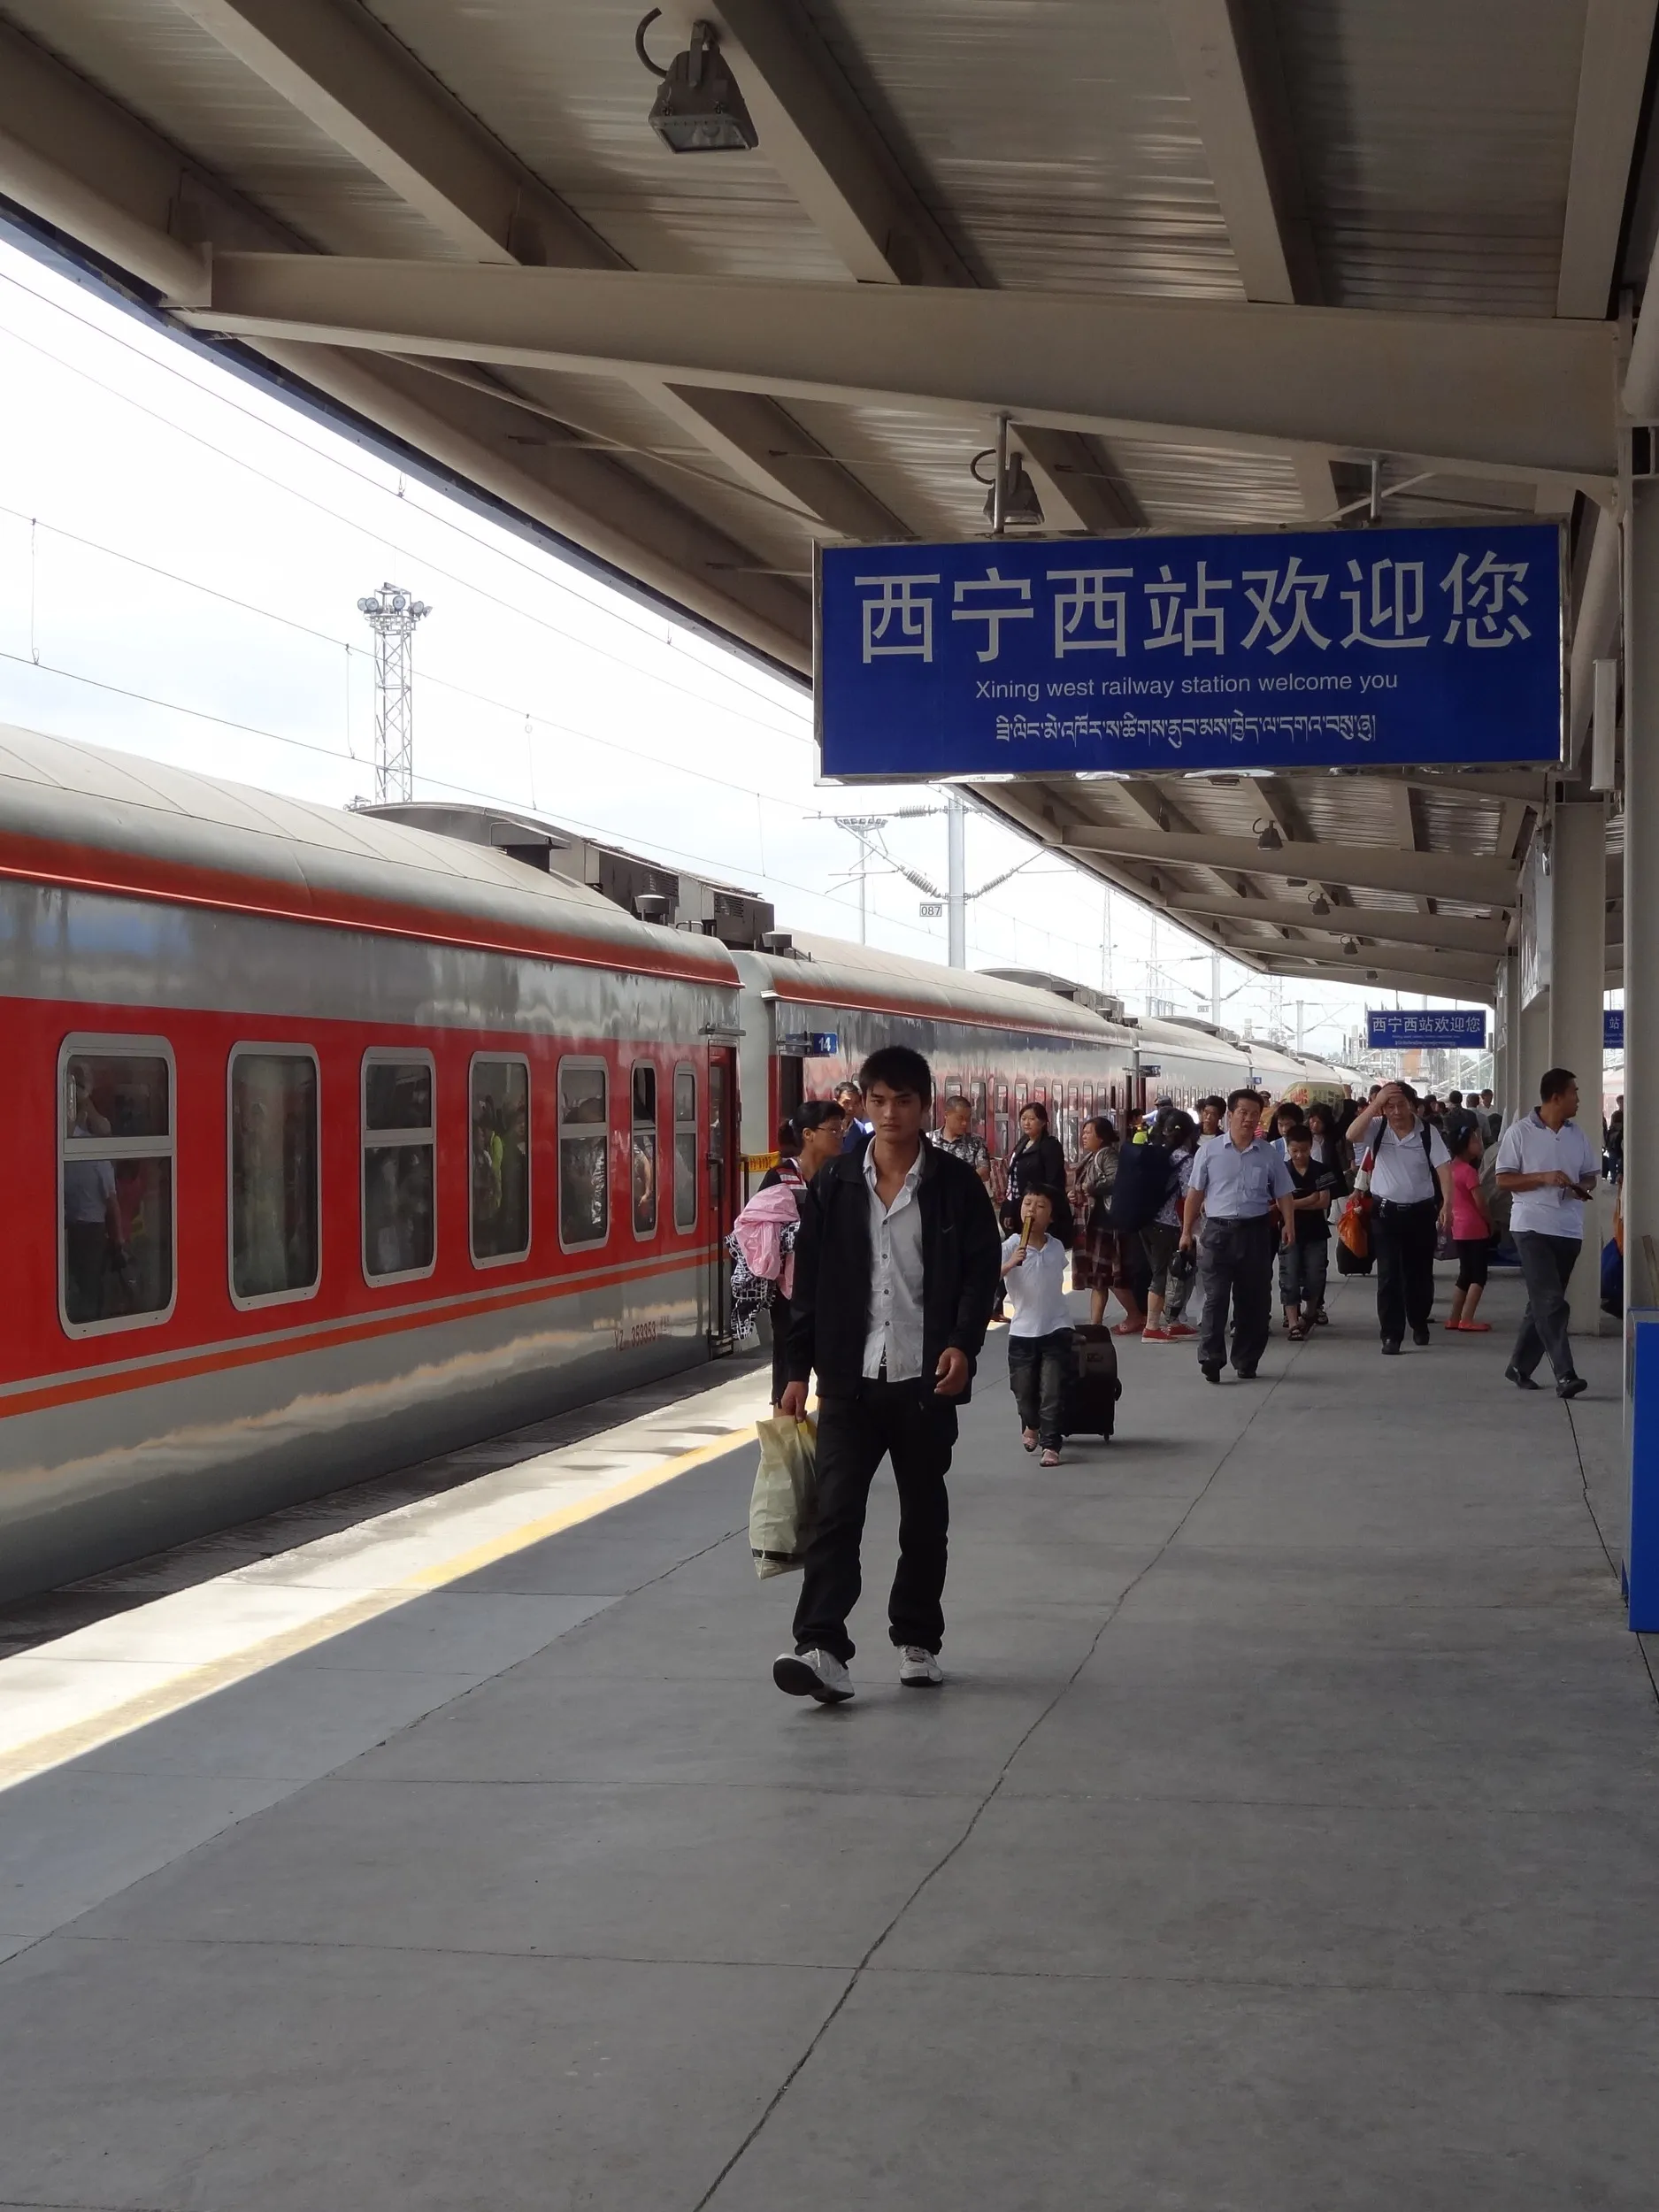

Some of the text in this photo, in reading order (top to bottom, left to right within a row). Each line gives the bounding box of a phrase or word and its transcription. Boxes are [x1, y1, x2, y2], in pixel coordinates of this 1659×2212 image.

[853, 549, 1532, 664] 西宁西站欢迎您
[975, 673, 1399, 703] Xining west railway station welcome you
[921, 906, 941, 916] 087
[1371, 1016, 1481, 1033] 西宁西站欢迎您
[818, 1036, 832, 1051] 14
